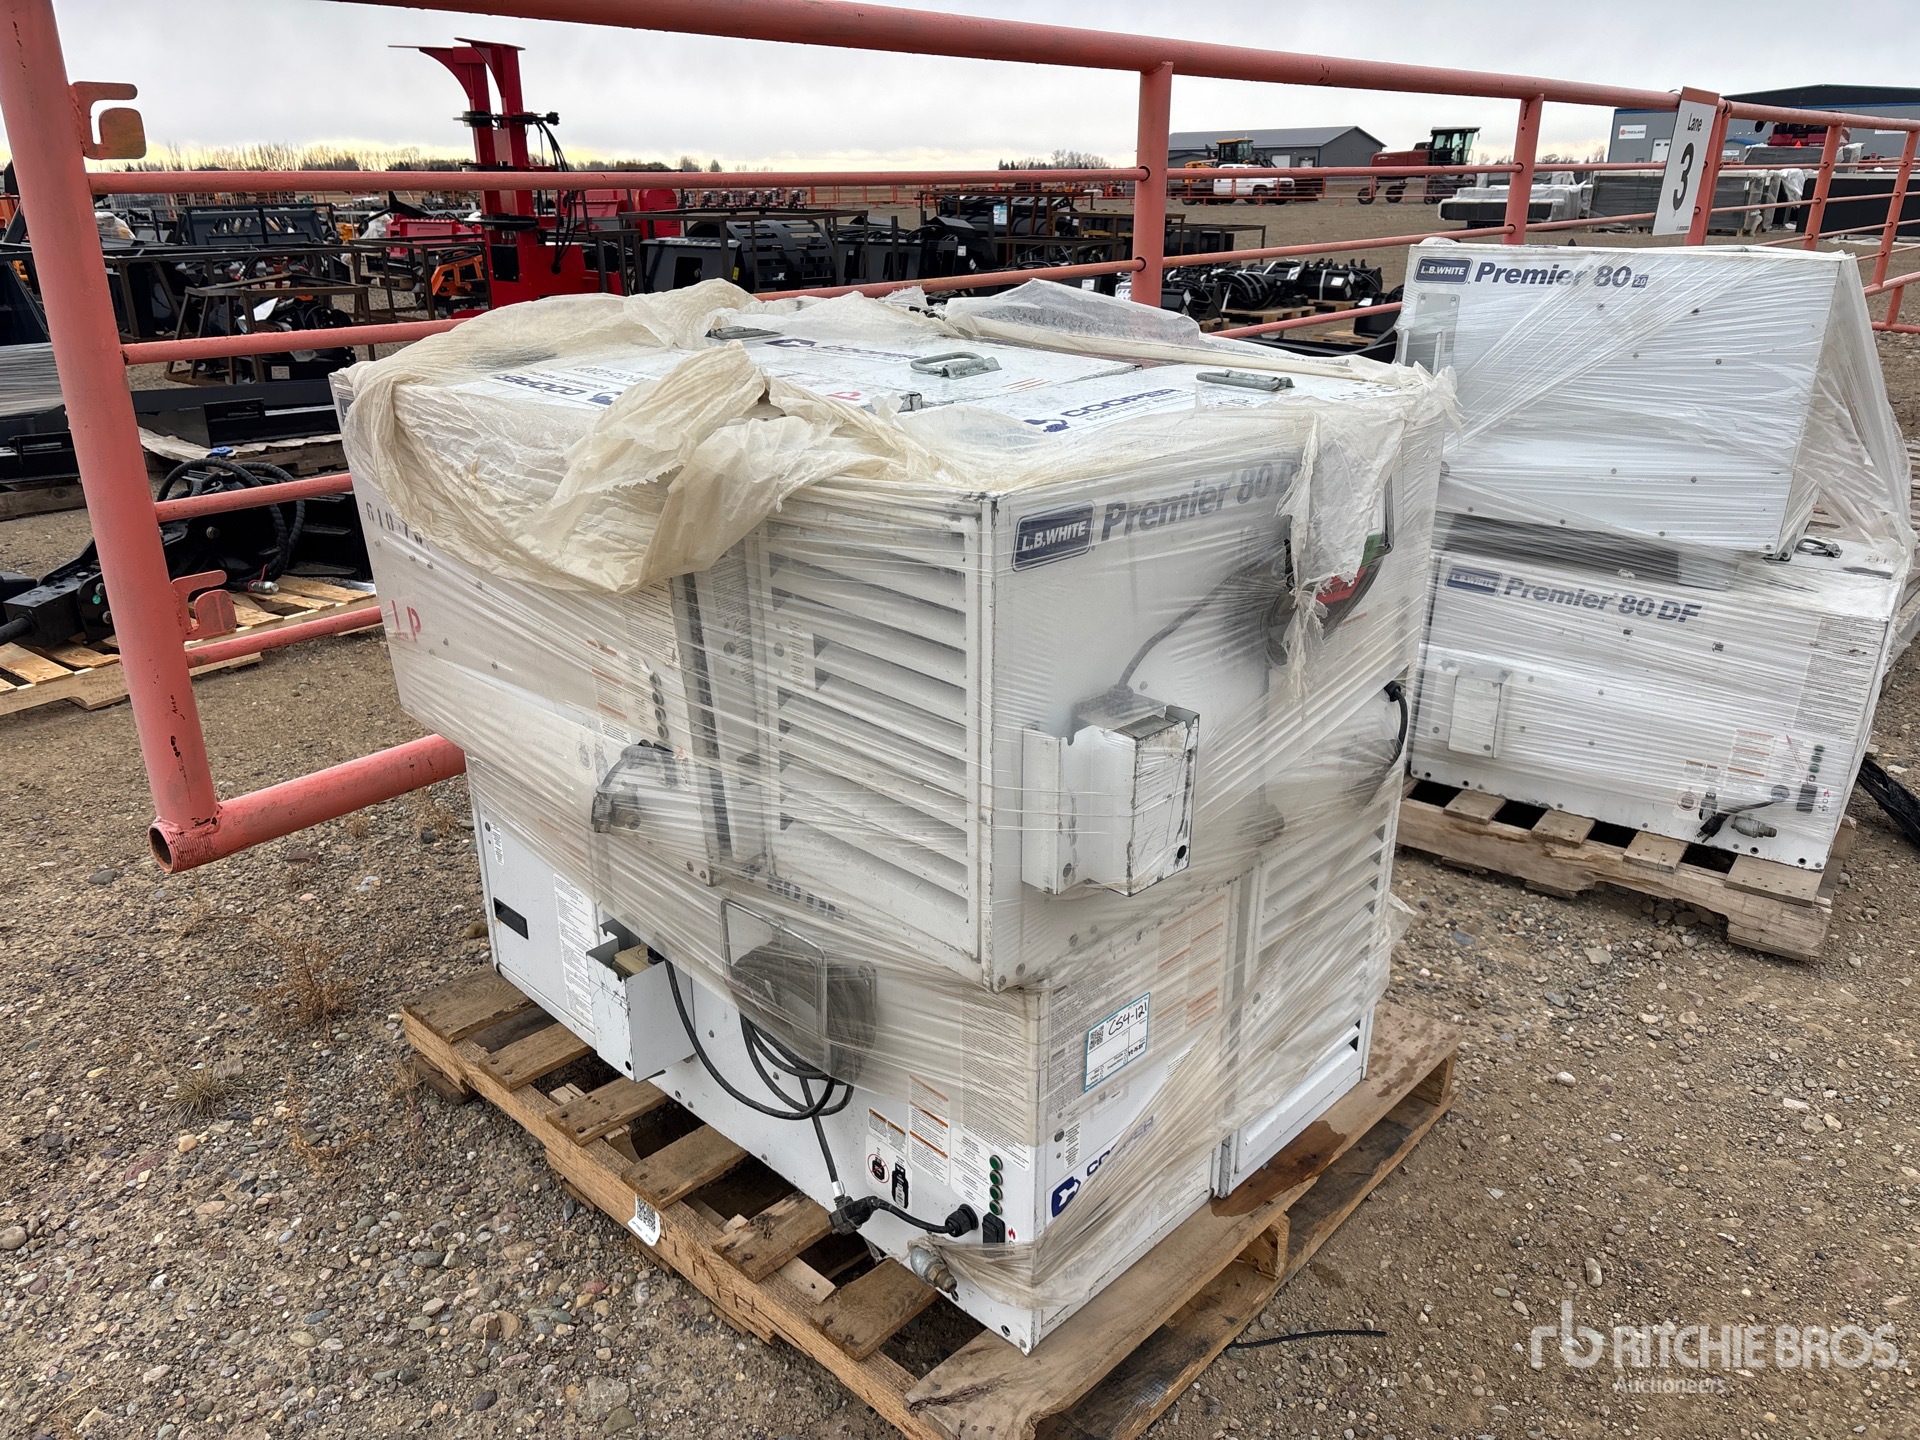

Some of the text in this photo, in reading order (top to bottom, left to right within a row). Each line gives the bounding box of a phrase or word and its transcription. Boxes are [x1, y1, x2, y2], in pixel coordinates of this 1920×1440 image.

[1687, 112, 1702, 132] Lane
[1672, 142, 1694, 211] 3
[1420, 264, 1466, 276] L.B.WHITE
[1474, 262, 1588, 286] Premier
[1593, 265, 1632, 288] 80
[1060, 388, 1180, 417] COOPER
[1021, 520, 1088, 551] L.B.WHITE
[1101, 479, 1230, 542] Premier
[1236, 462, 1273, 504] 80
[391, 599, 422, 643] LP
[1504, 576, 1613, 611] Premier
[1617, 594, 1655, 617] 80
[1657, 600, 1702, 623] DF
